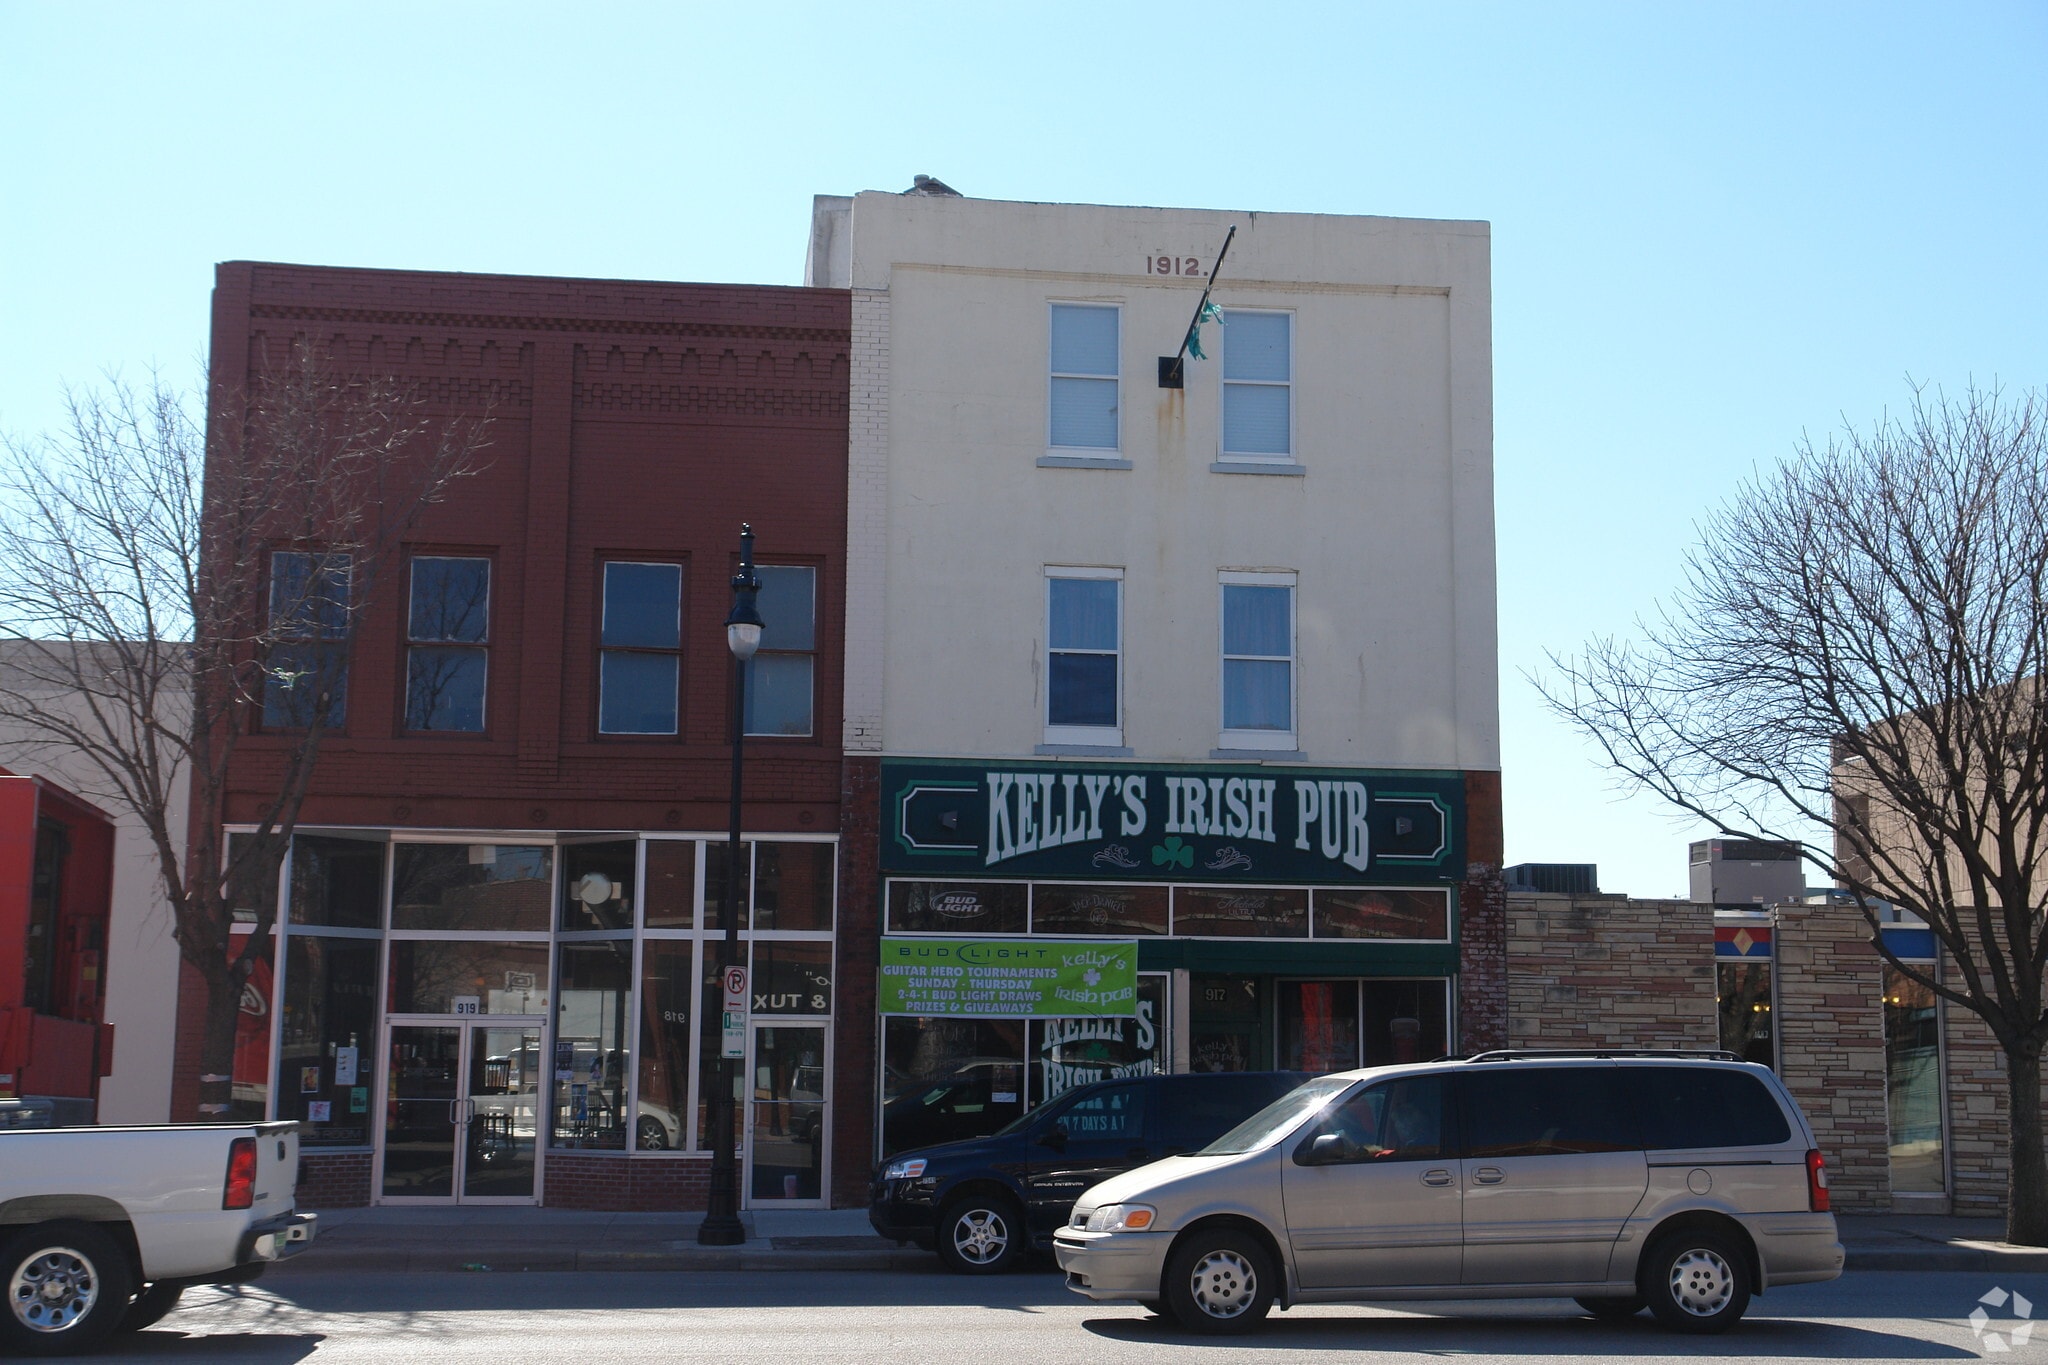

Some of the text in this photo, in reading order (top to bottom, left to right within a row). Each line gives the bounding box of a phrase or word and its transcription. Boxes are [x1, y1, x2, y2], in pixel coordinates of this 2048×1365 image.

[985, 772, 1371, 873] KELLY'S IRISH PUB
[943, 896, 977, 904] BUD
[936, 904, 983, 912] LIGHT
[899, 947, 1048, 959] BUD LIGHT
[883, 966, 1058, 979] GUITAR HERO TOURNAMENTS
[908, 978, 958, 989] SUNDAY
[969, 979, 1032, 990] THURSDAY
[898, 990, 1042, 1001] 2-4-1 BUD LIGHT DRAWS
[1205, 988, 1226, 1001] 917
[457, 1003, 476, 1014] 919
[906, 1001, 1034, 1013] PRIZES & GIVEAWAYS
[1073, 1116, 1079, 1130] 7
[1082, 1116, 1107, 1130] DAYS
[1111, 1116, 1117, 1130] A
